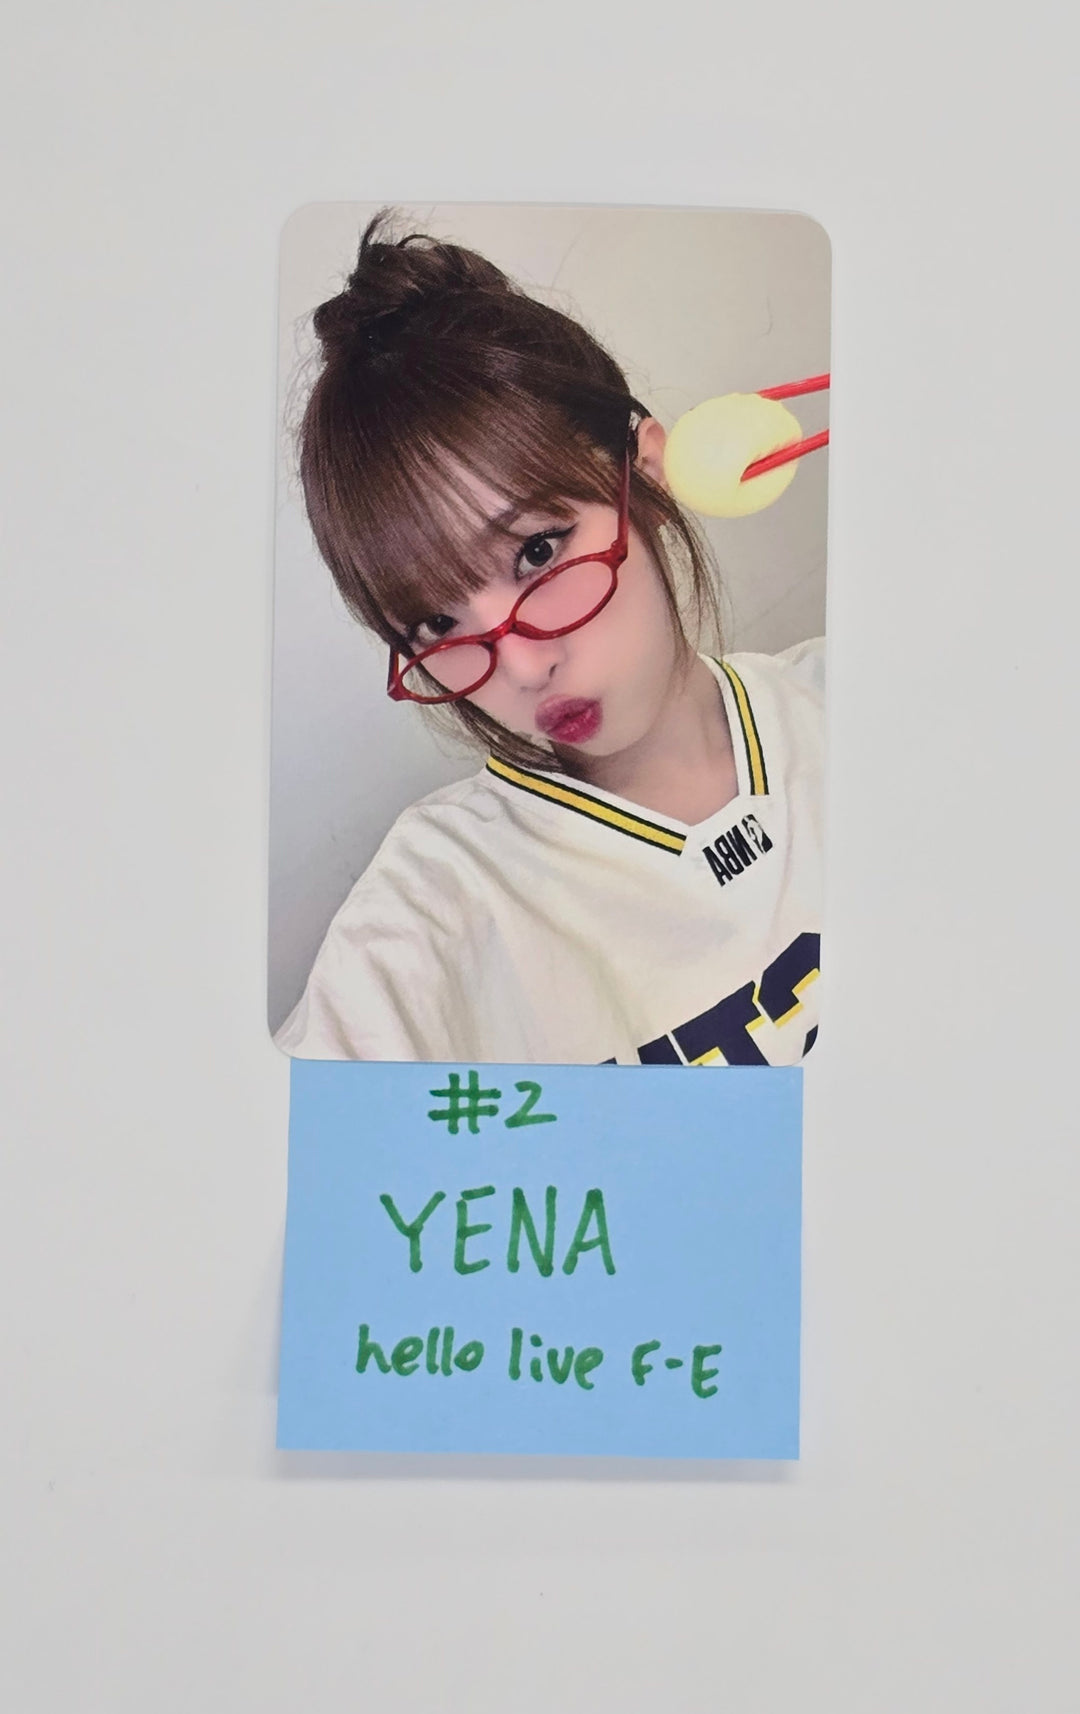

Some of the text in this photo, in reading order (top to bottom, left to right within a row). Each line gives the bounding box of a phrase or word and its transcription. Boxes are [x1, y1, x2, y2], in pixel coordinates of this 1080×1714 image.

[427, 1069, 558, 1136] #2
[379, 1184, 617, 1278] YENA
[354, 1323, 722, 1400] hello live F-E
